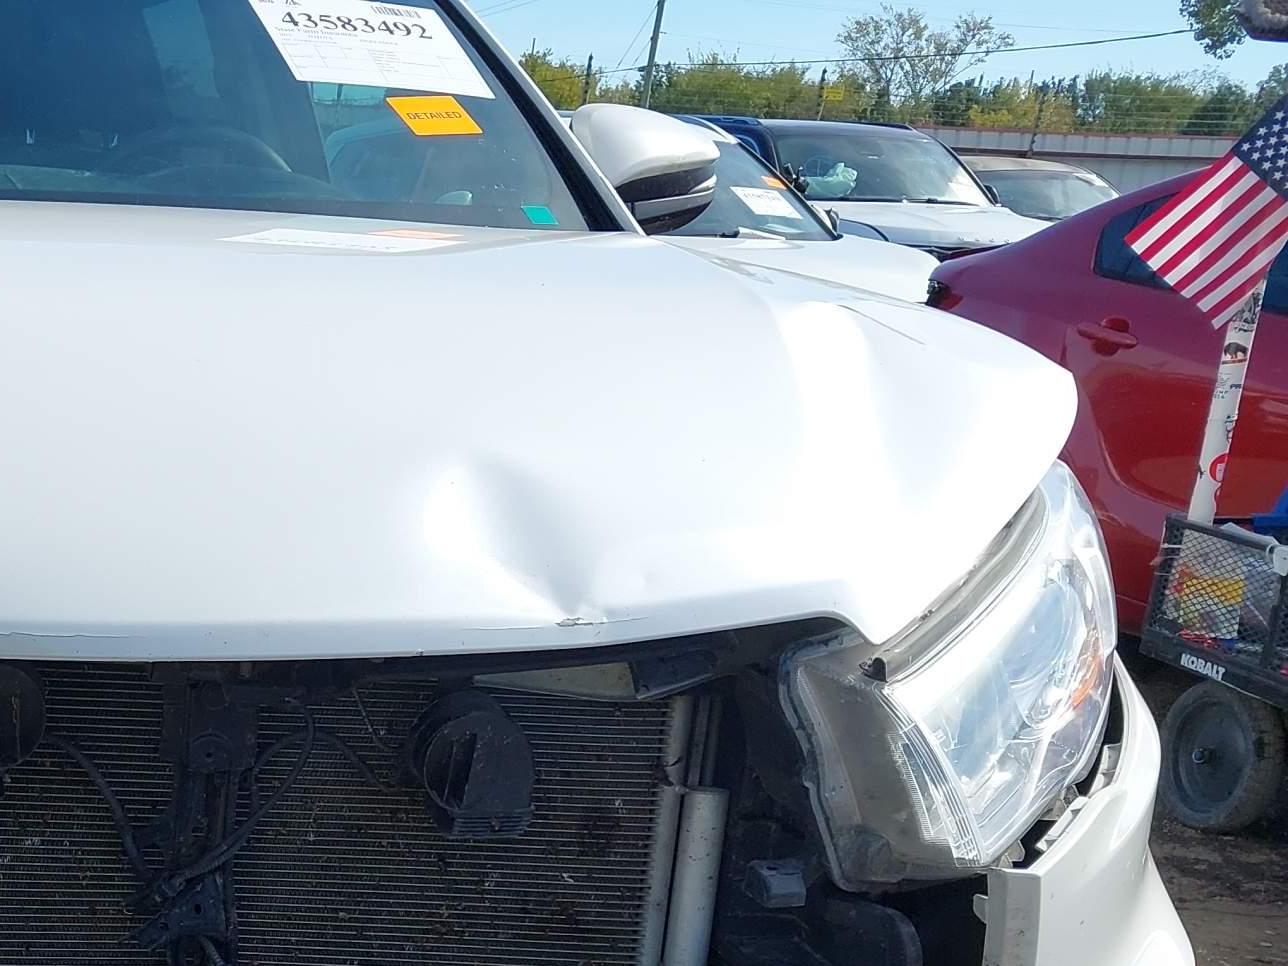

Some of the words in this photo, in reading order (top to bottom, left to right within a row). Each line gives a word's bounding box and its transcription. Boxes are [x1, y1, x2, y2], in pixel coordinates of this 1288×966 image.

[282, 11, 433, 40] 43583492
[406, 111, 462, 120] DETAILED
[1180, 653, 1226, 681] KOBALT
